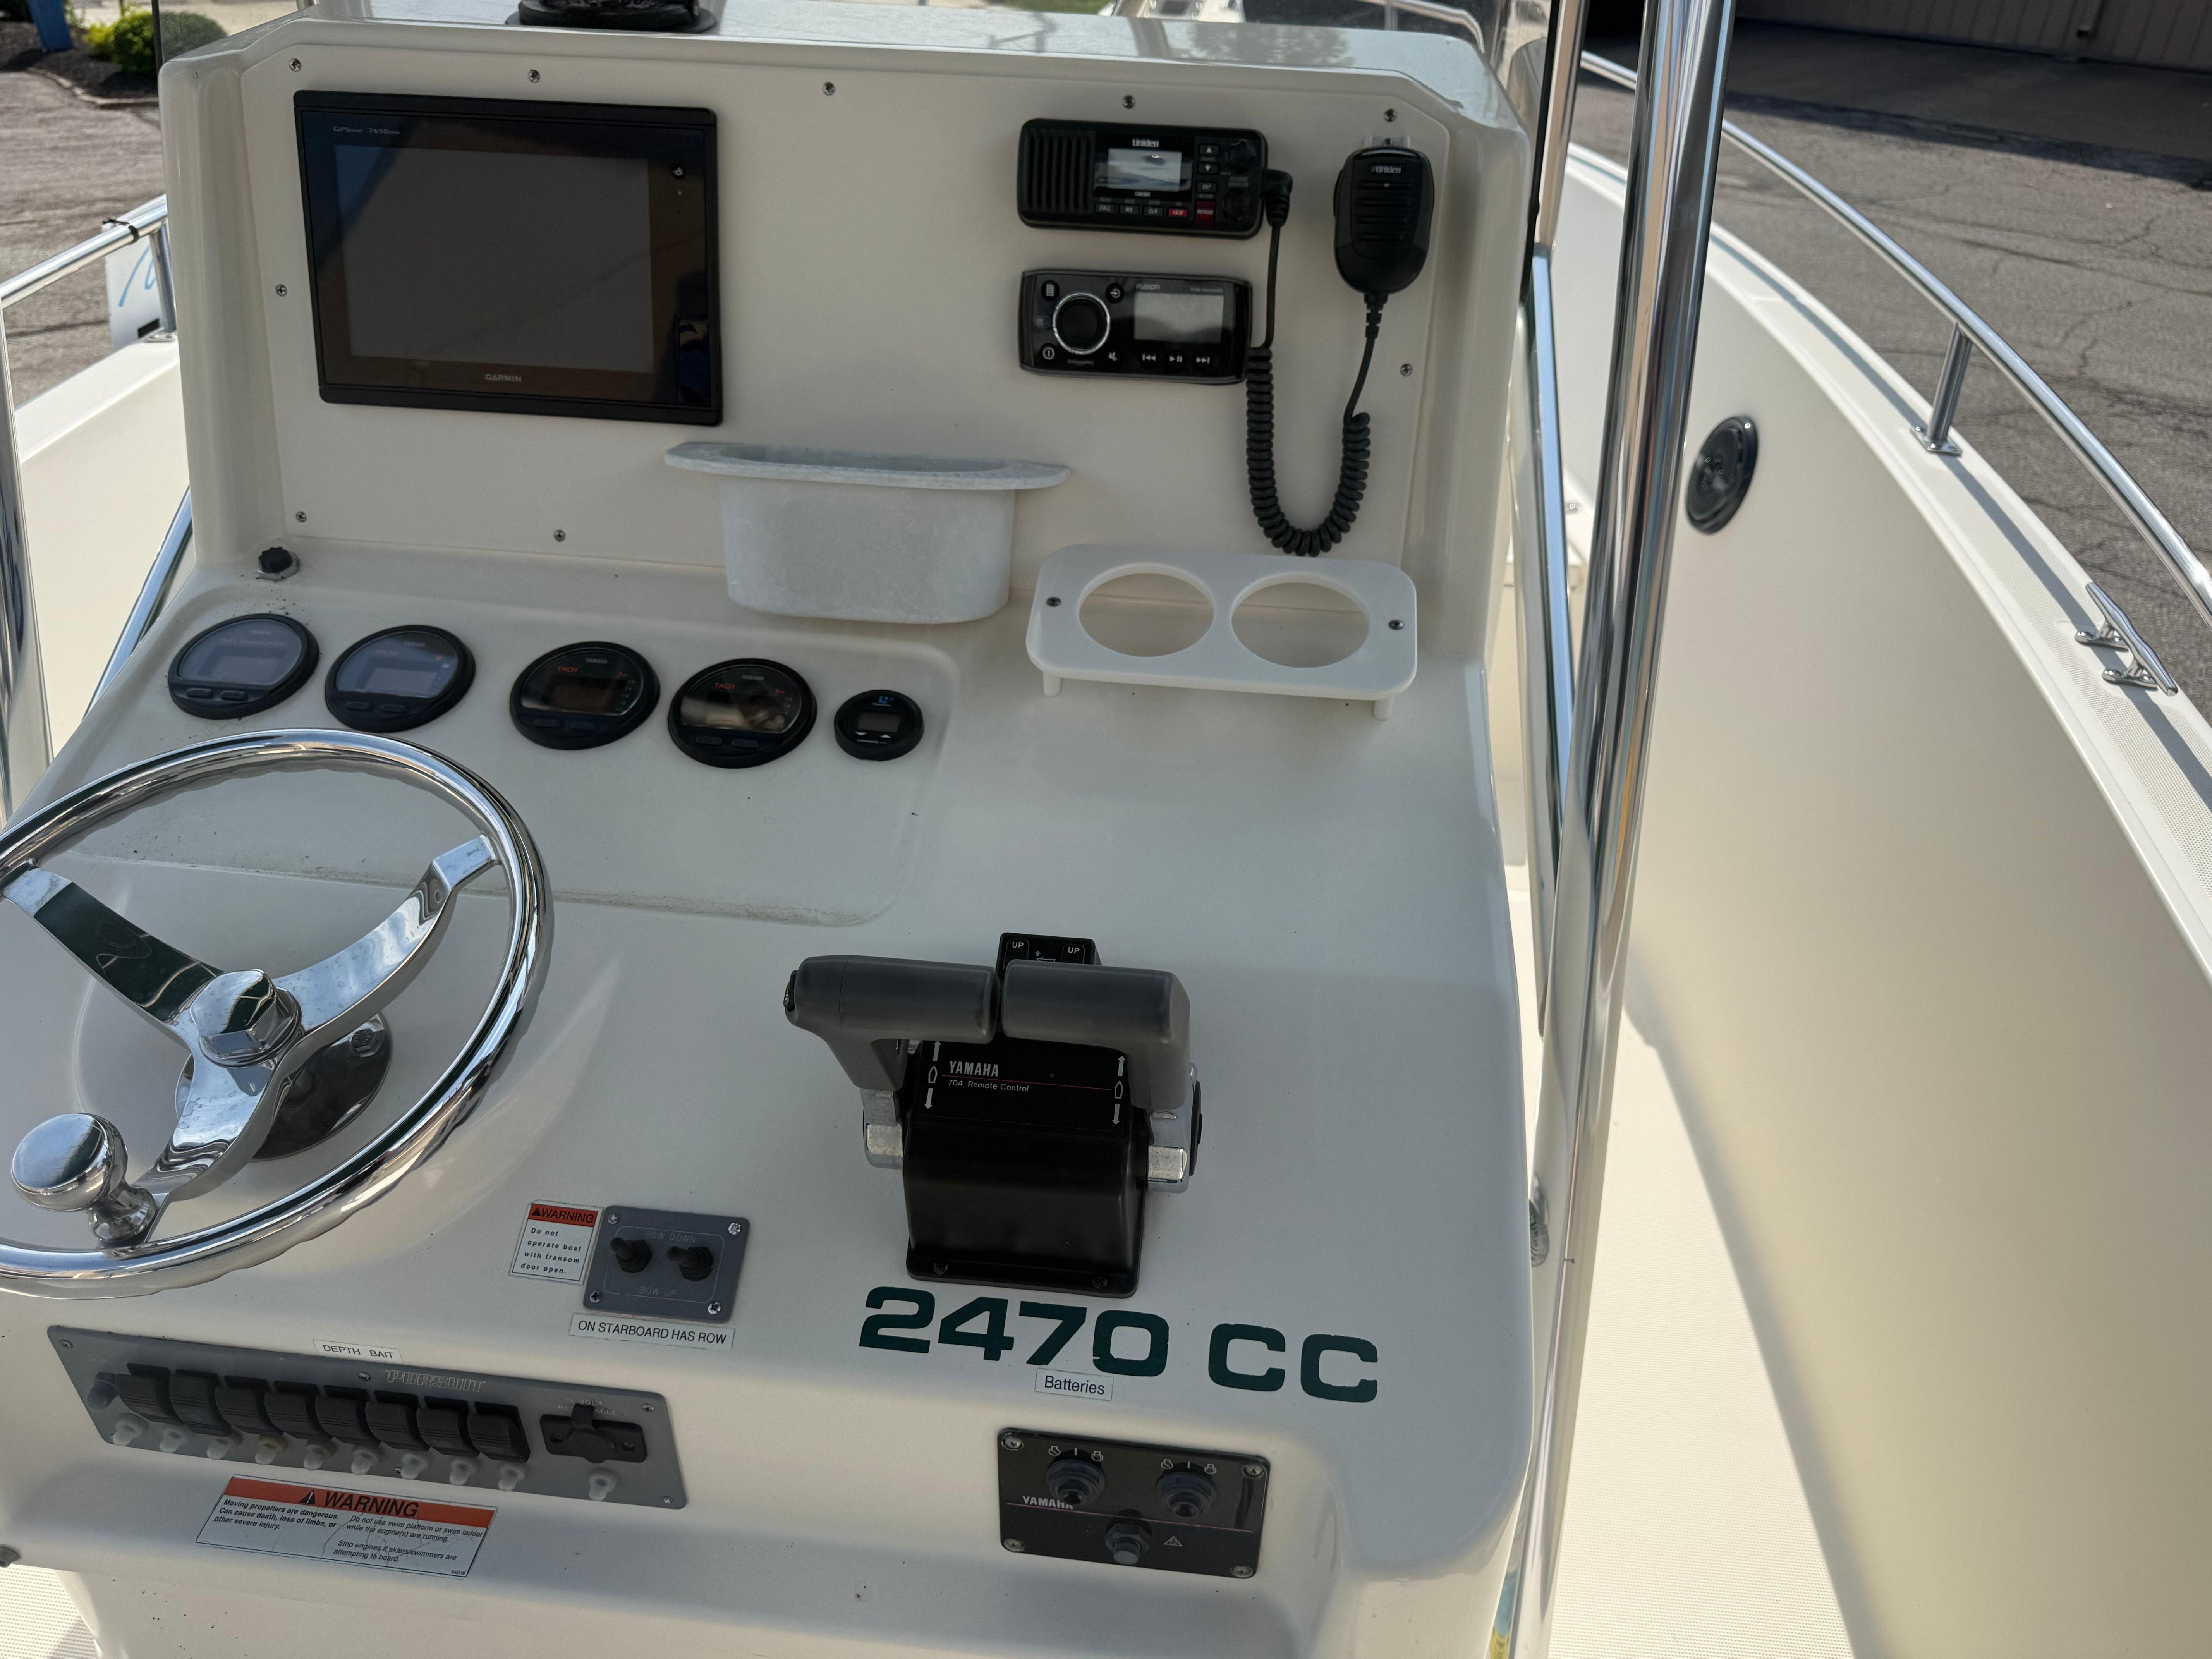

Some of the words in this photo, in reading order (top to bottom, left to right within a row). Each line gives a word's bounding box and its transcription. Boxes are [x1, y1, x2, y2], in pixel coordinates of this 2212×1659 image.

[1132, 138, 1159, 148] Uniden
[1376, 165, 1401, 173] Uniden
[485, 374, 522, 382] GARMIN
[950, 1060, 998, 1077] YAMAHA
[968, 1081, 997, 1089] Remote
[1000, 1083, 1029, 1092] Control
[542, 1208, 594, 1223] WARNING
[645, 1231, 665, 1239] BOW
[670, 1233, 697, 1242] DOWN
[527, 1240, 560, 1249] operate
[546, 1252, 579, 1263] transom
[639, 1286, 660, 1295] BOW
[579, 1320, 596, 1331] ON
[598, 1322, 669, 1338] STARBOARD
[672, 1330, 695, 1341] HAS
[698, 1332, 727, 1344] ROW
[859, 1285, 1170, 1377] 2470
[1208, 1323, 1379, 1403] CC
[323, 1345, 361, 1355] DEPTH
[369, 1350, 394, 1358] BAIT
[385, 1369, 486, 1393] PURSUIT
[1045, 1375, 1105, 1395] Batteries
[223, 1499, 249, 1508] Moving
[249, 1503, 285, 1513] propellers
[300, 1509, 339, 1519] dangerous.
[325, 1491, 419, 1518] WARNING
[256, 1513, 278, 1521] death,
[306, 1519, 326, 1527] limbs,
[259, 1521, 280, 1530] injury.
[377, 1528, 409, 1539] engine(s)
[422, 1534, 449, 1543] running.
[405, 1522, 433, 1532] platform
[462, 1530, 484, 1538] ladder
[333, 1549, 369, 1559] attempting
[378, 1554, 400, 1562] board.
[338, 1540, 354, 1548] Stop
[355, 1542, 381, 1551] engines
[388, 1546, 444, 1559] skiers/swimmers
